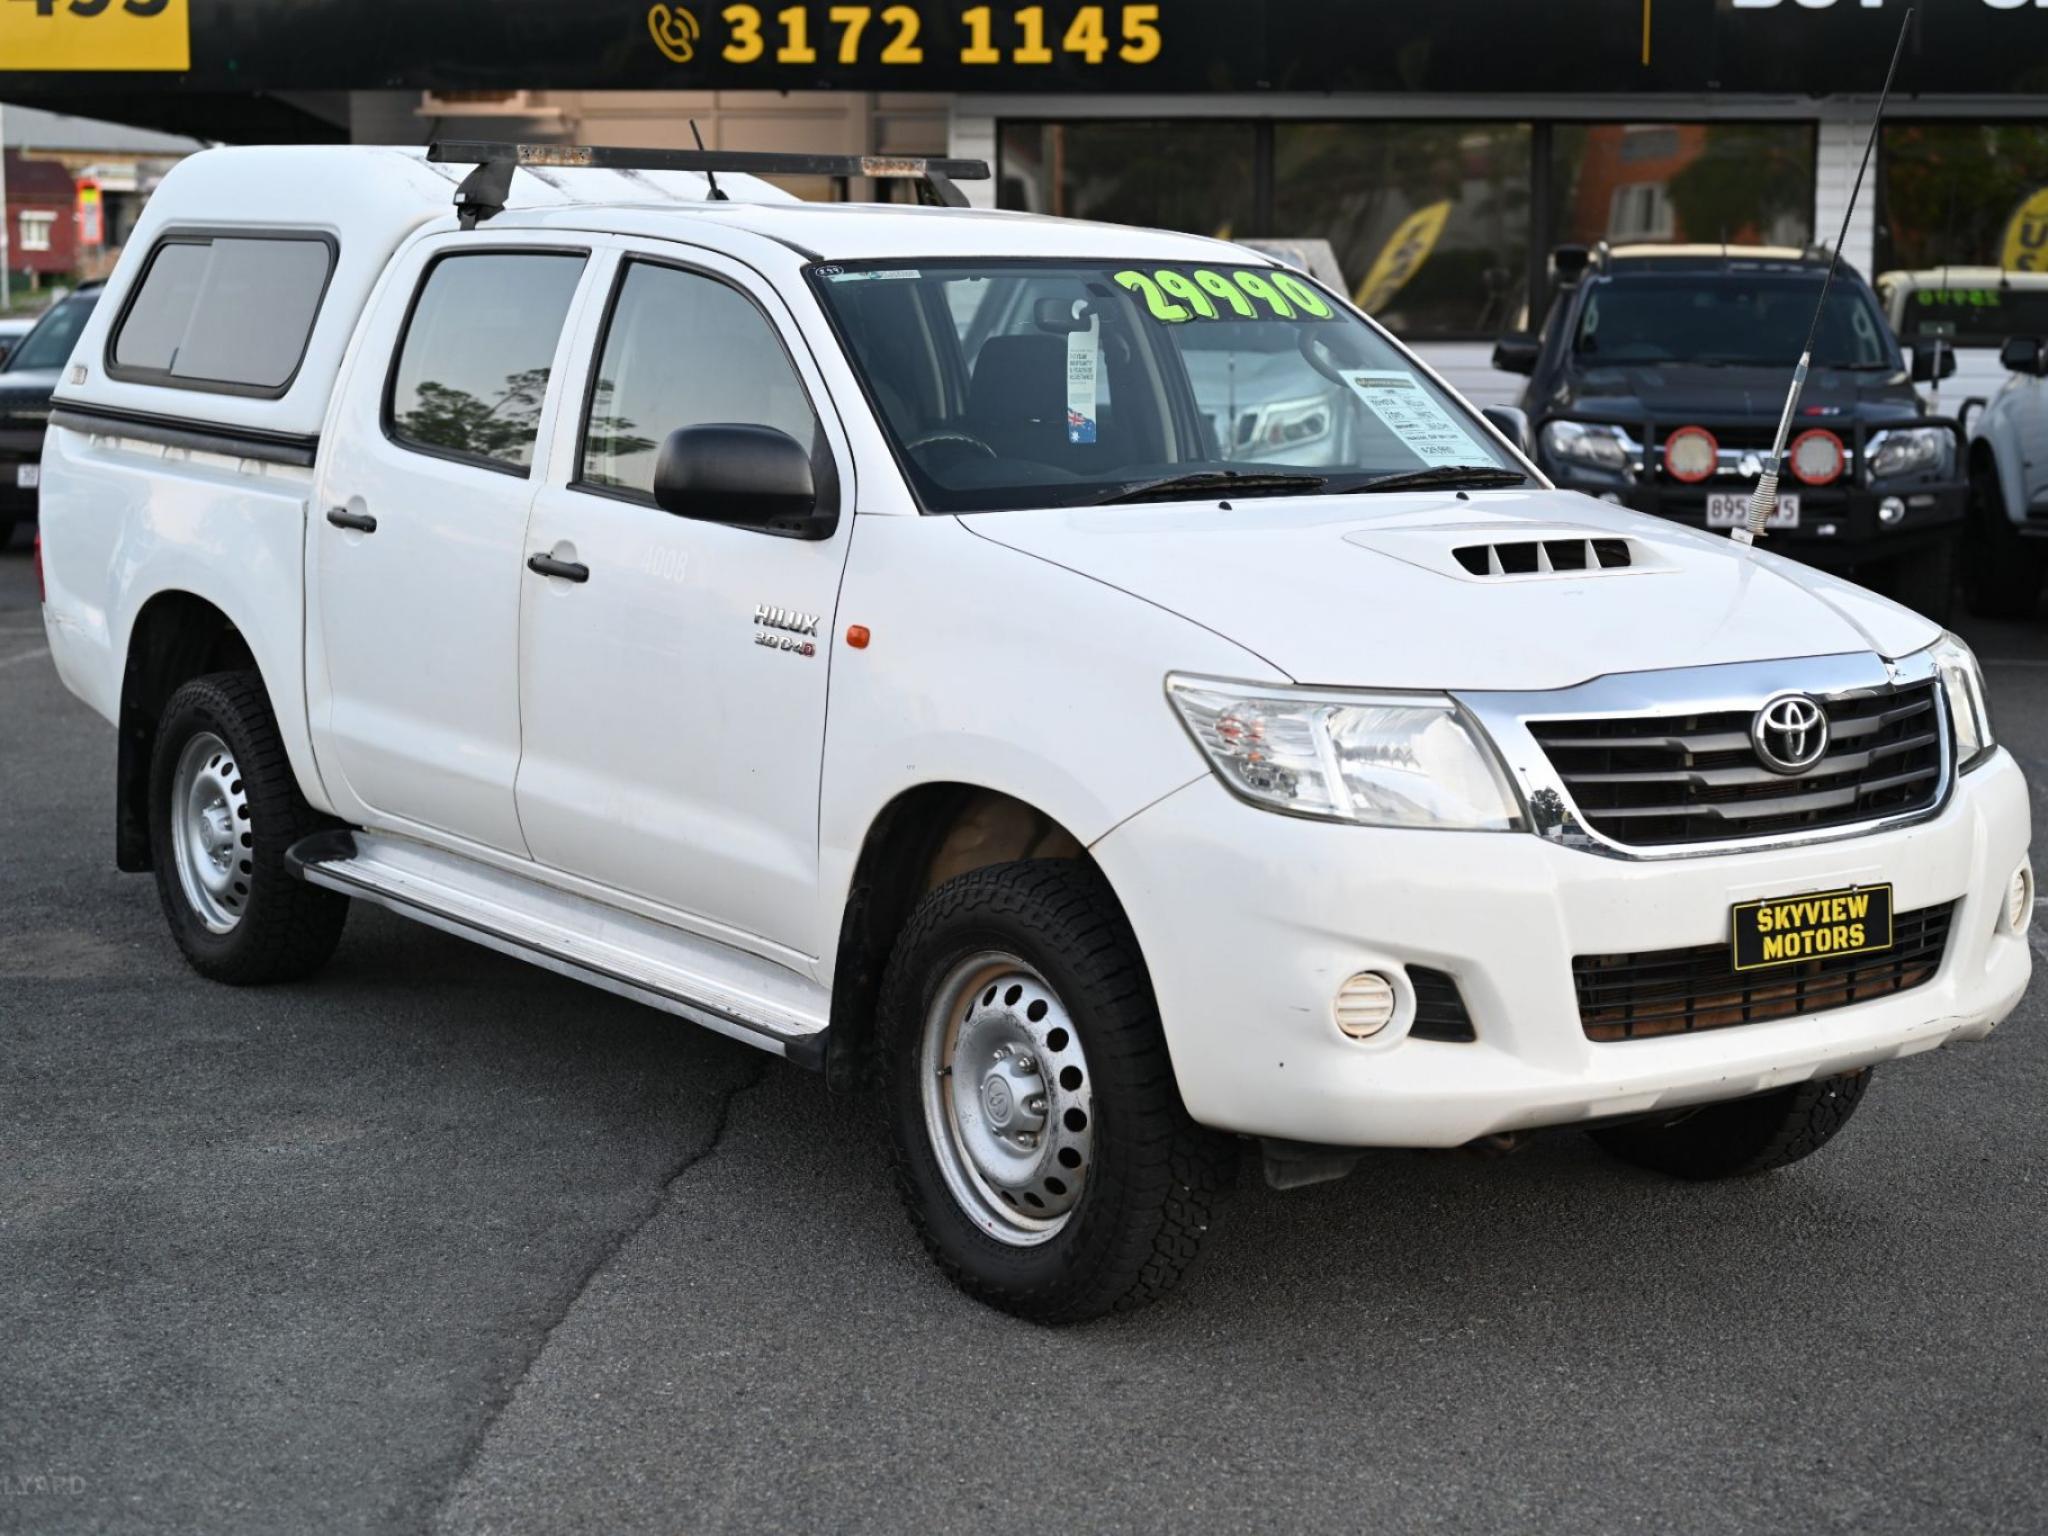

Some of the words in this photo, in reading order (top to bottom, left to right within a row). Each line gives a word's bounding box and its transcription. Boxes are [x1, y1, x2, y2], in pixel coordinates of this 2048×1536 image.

[720, 4, 924, 63] 3172
[960, 4, 1162, 63] 1145
[1113, 269, 1335, 323] 29990
[1711, 498, 1795, 520] 8955
[753, 603, 820, 637] HILUX
[1757, 894, 1869, 932] SKYVIEW
[1763, 923, 1866, 960] MOTORS
